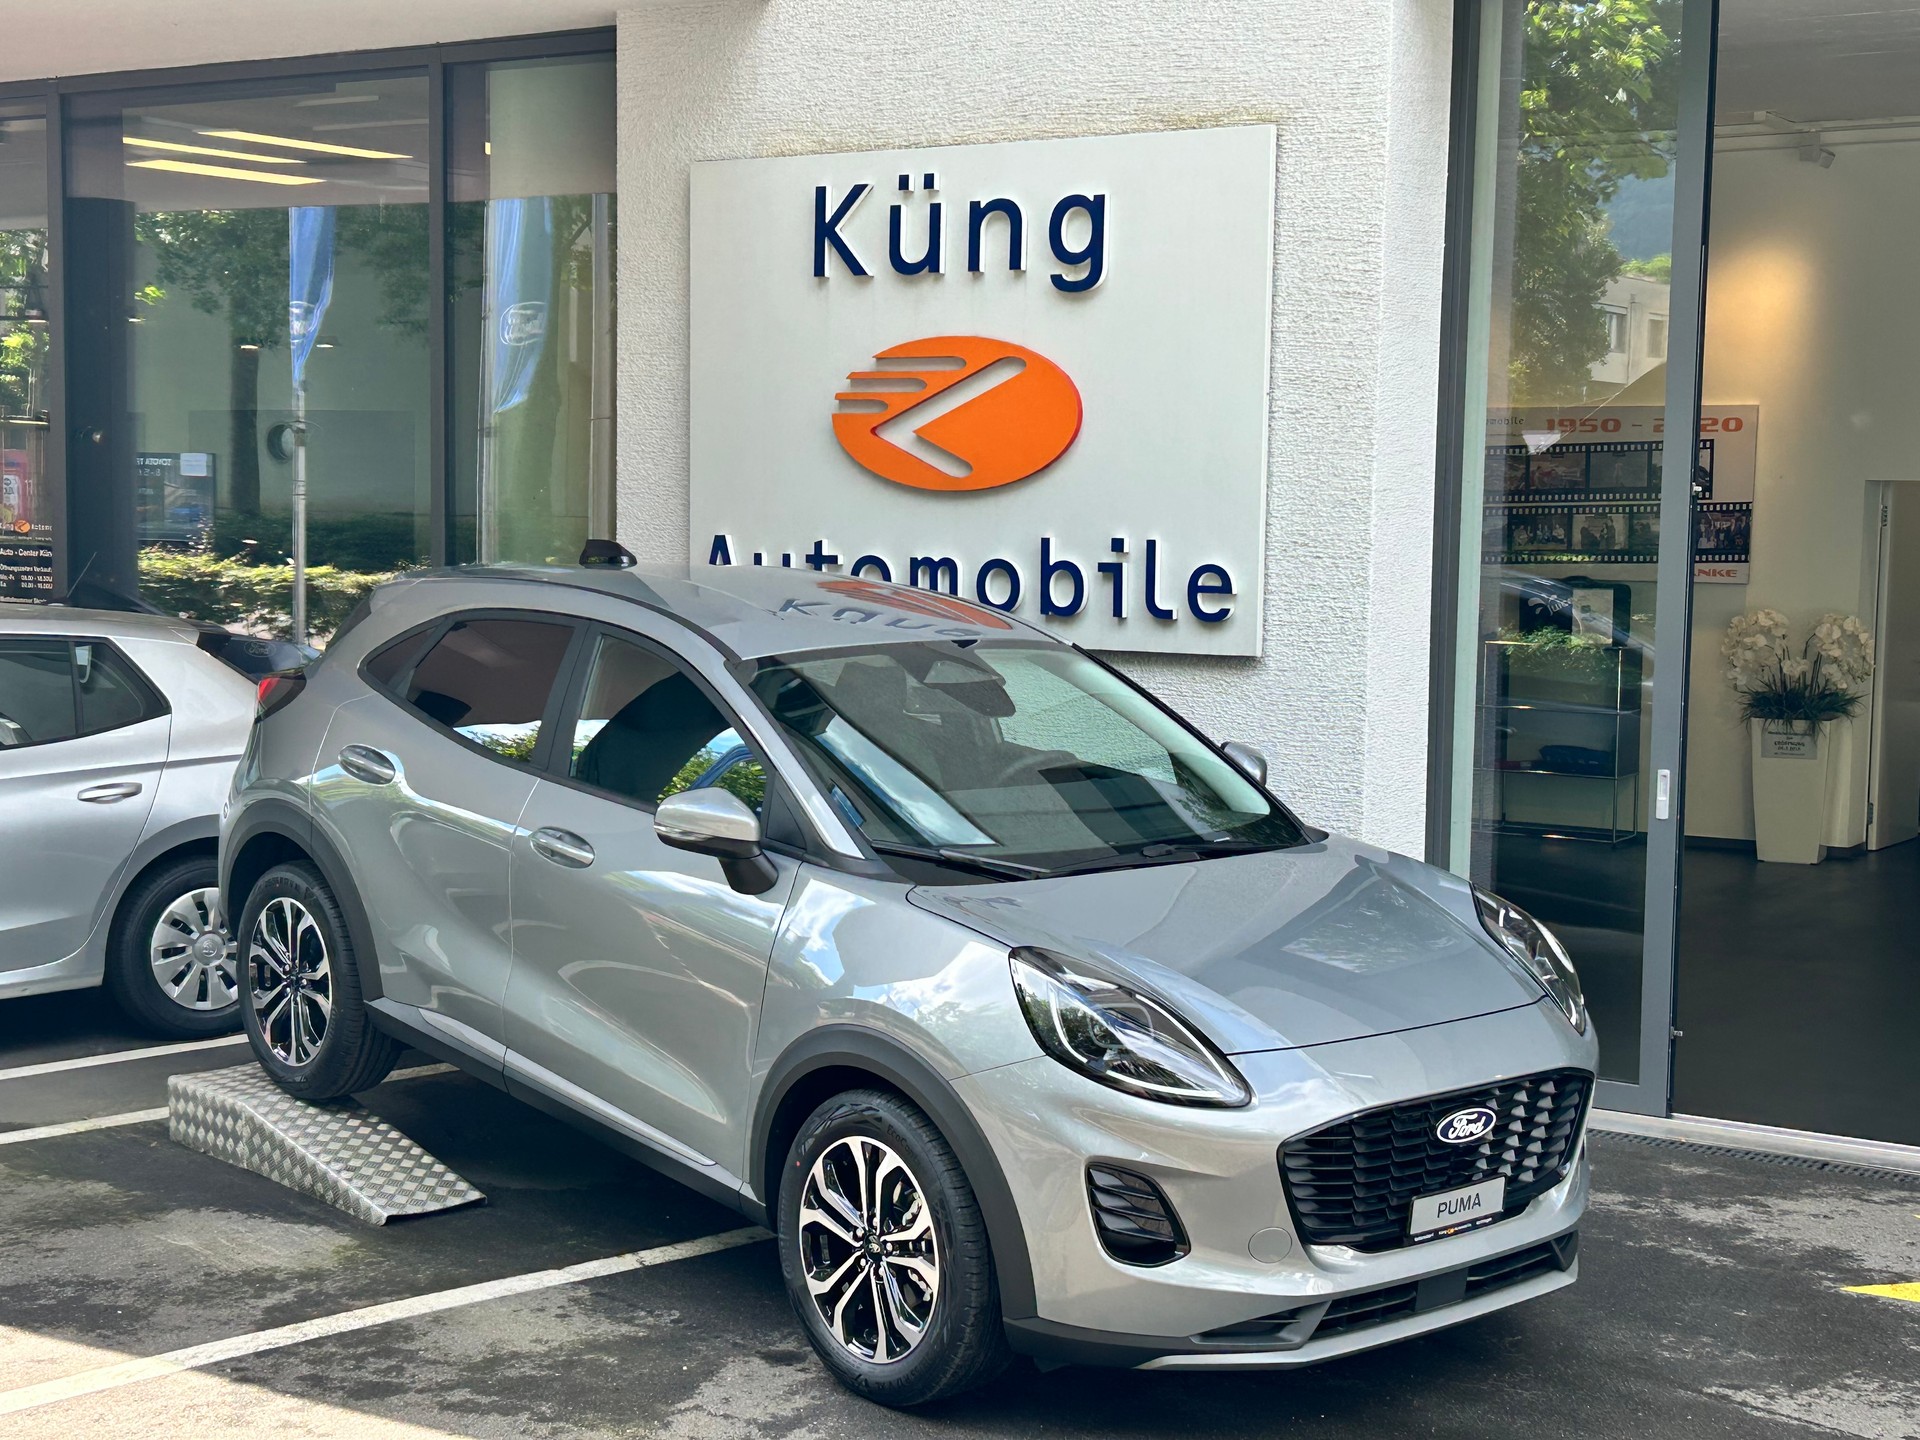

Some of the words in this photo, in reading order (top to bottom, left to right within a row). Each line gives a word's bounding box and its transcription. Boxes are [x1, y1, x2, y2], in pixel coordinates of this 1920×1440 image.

[813, 172, 1111, 293] Küng
[1546, 418, 1621, 433] 1950
[1653, 417, 1743, 433] 220
[708, 534, 1238, 623] mobile
[1694, 568, 1738, 578] NKE
[1448, 1113, 1487, 1139] Ford
[1436, 1192, 1482, 1219] PUMA
